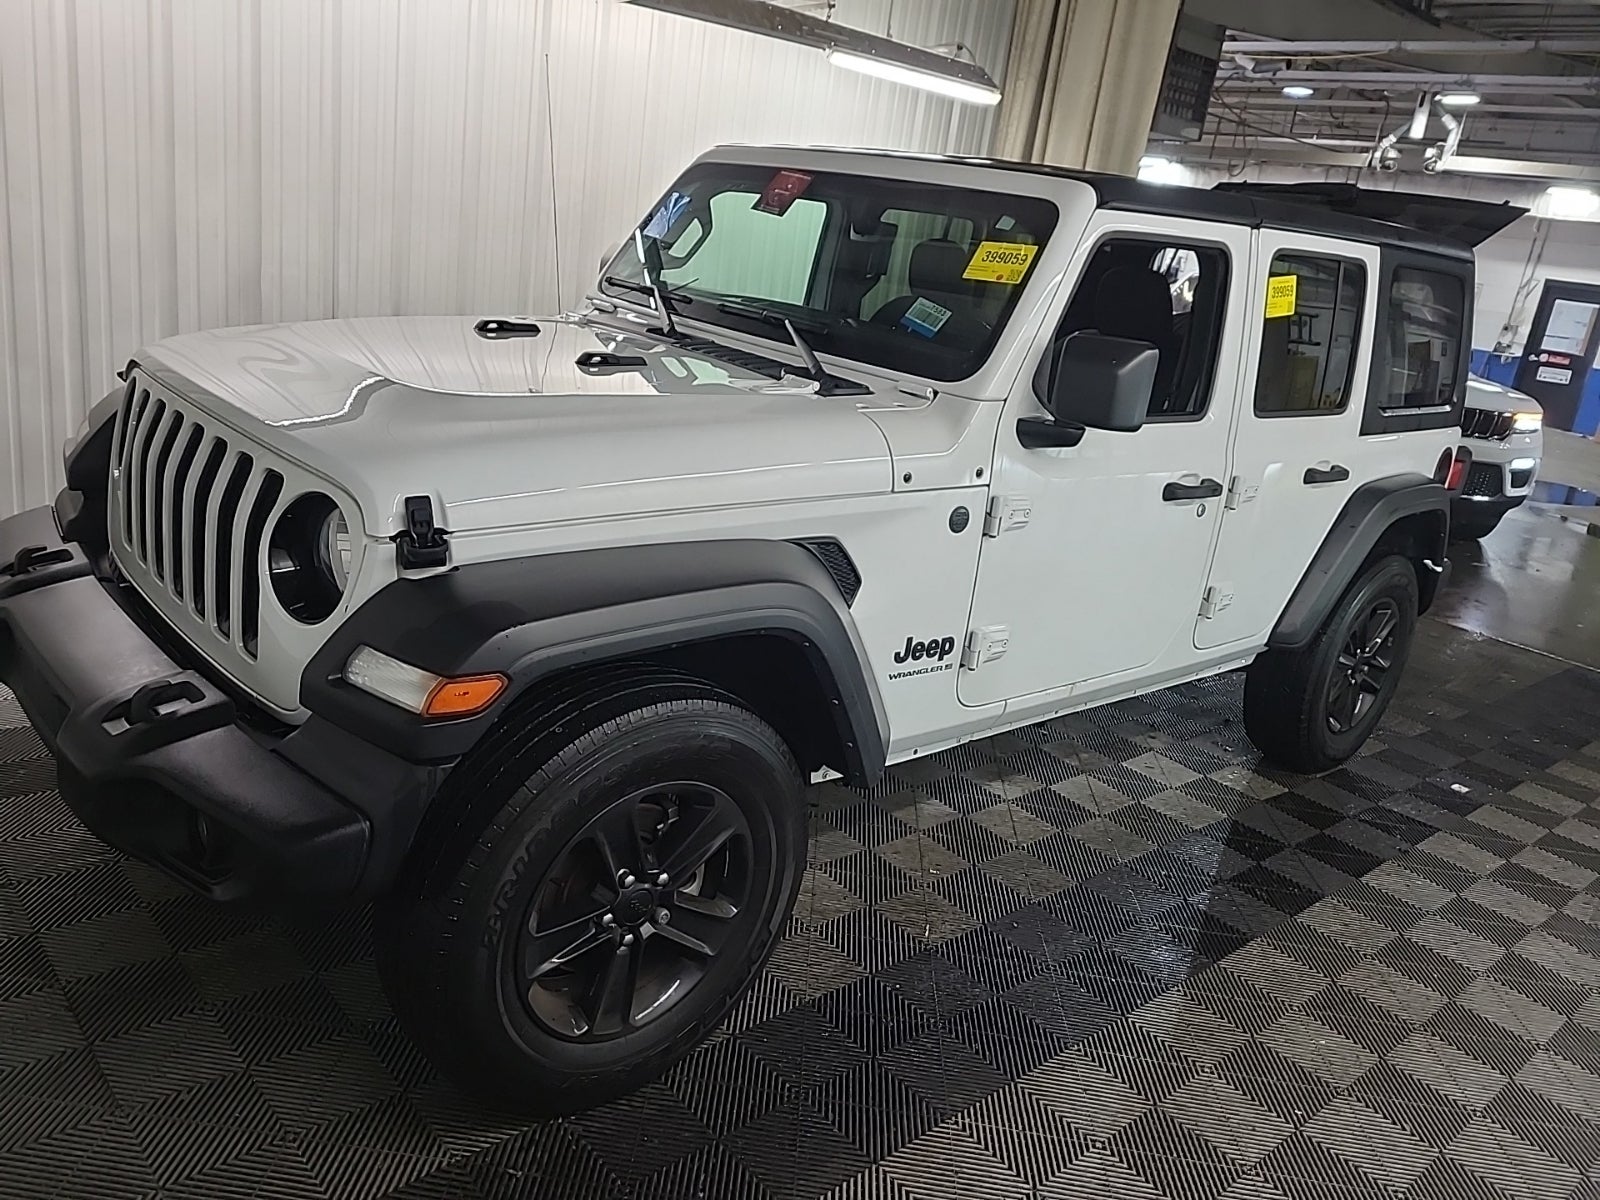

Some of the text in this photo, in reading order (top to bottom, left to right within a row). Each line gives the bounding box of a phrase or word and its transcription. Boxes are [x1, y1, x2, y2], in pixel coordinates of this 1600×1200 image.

[981, 250, 1028, 266] 399059
[893, 636, 955, 664] Jeep
[888, 665, 943, 680] WRANGLER
